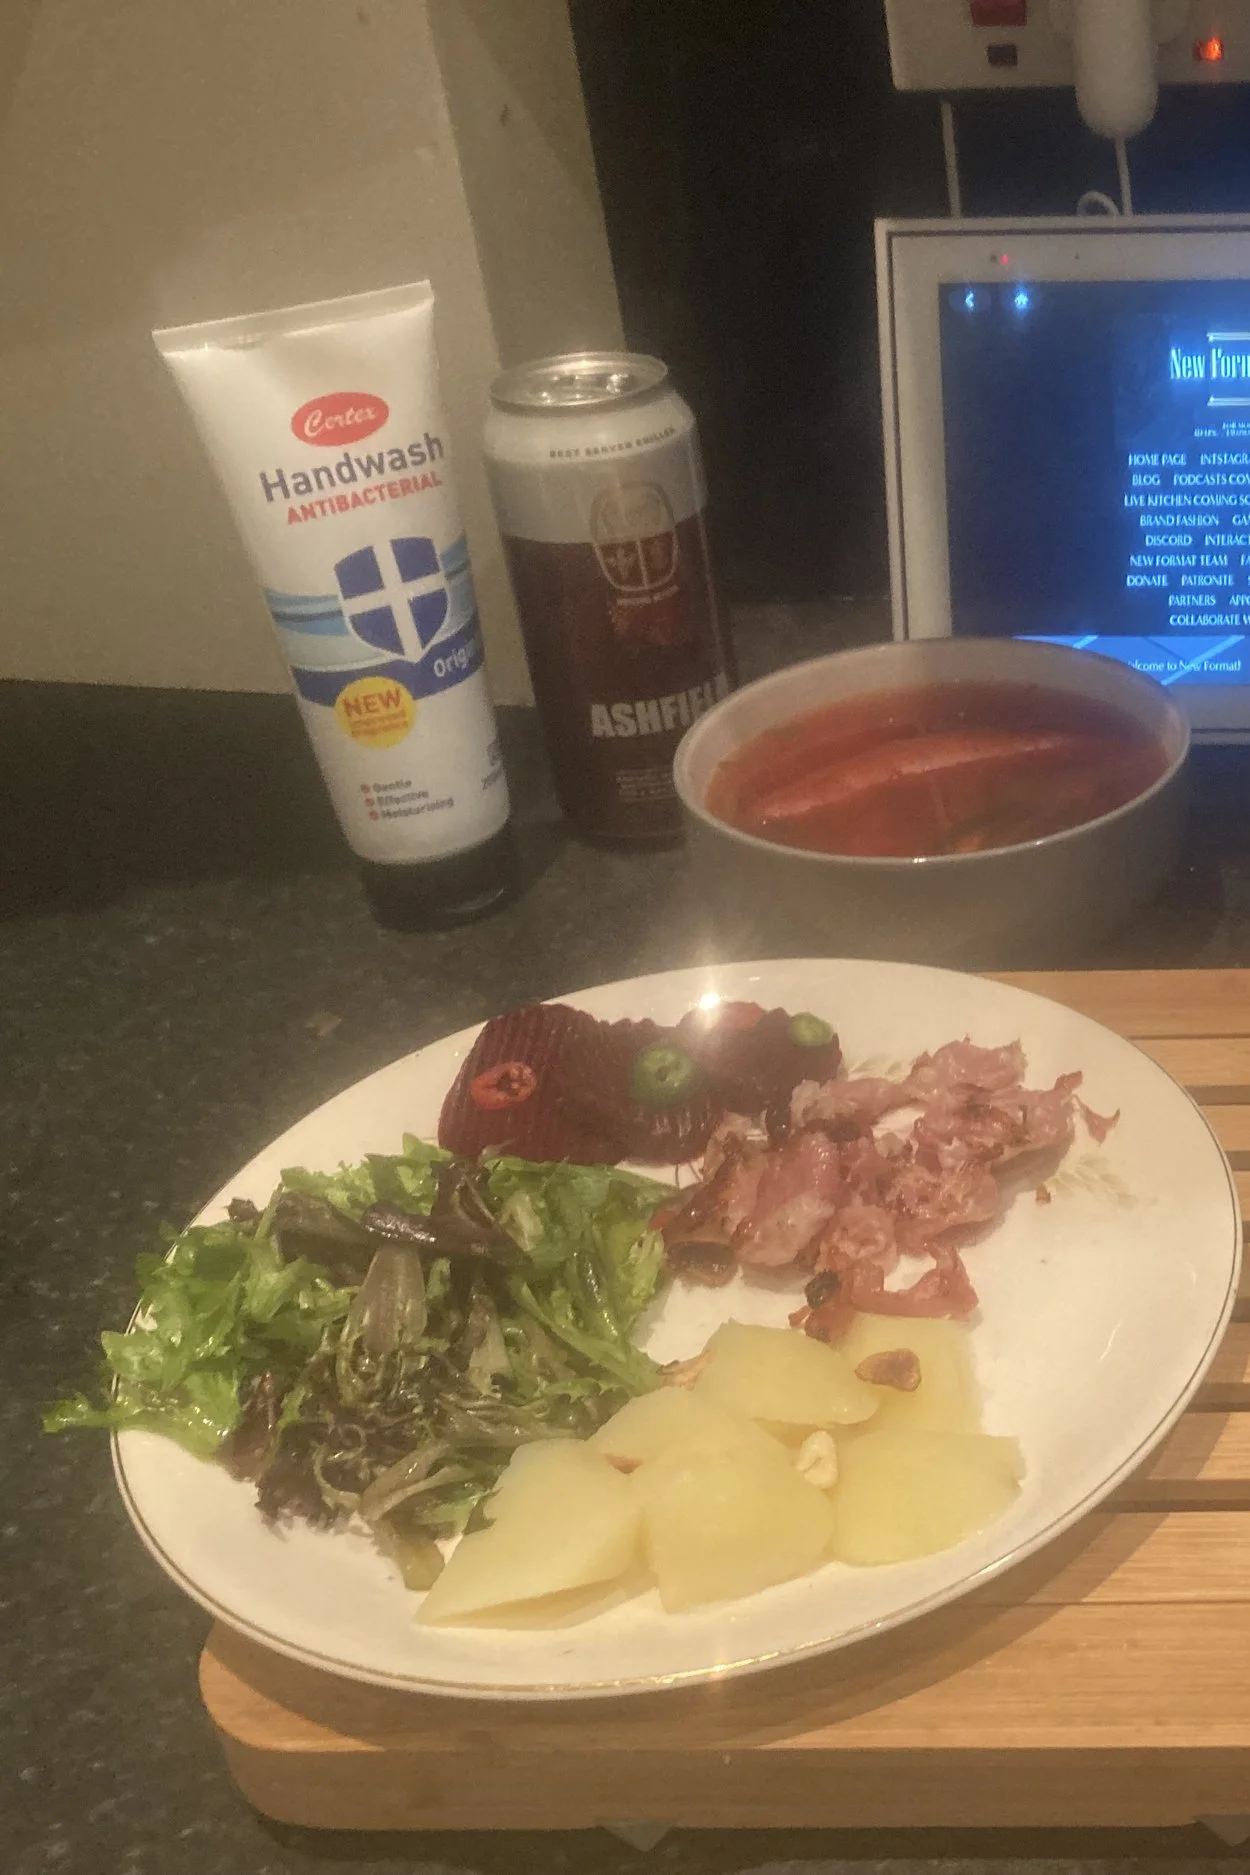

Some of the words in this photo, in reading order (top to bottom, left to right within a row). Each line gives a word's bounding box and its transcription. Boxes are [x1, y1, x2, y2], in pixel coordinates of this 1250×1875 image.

[1170, 347, 1206, 379] New
[1128, 453, 1160, 466] HOME
[1162, 453, 1187, 466] PAGE
[259, 432, 445, 503] Handwash
[1132, 473, 1161, 486] BLOG
[1173, 473, 1227, 486] PODCASTS
[287, 470, 443, 525] ANTIBACTERIAL
[1124, 493, 1146, 507] LIVE
[1147, 493, 1192, 506] KITCHEN
[1193, 493, 1238, 506] COMING
[1140, 513, 1175, 526] BRAND
[1176, 513, 1220, 526] FASHION
[1145, 534, 1193, 547] DISCORD
[1130, 554, 1155, 567] NEW
[1155, 554, 1197, 567] FORMAT
[1200, 554, 1228, 567] TEAM
[1126, 574, 1168, 587] DONATE
[1168, 594, 1217, 607] PARTNERS
[1169, 613, 1241, 626] COLLABORATE
[1129, 660, 1164, 672] lcome
[1166, 660, 1177, 671] to
[1178, 659, 1200, 671] New
[343, 688, 401, 717] NEW
